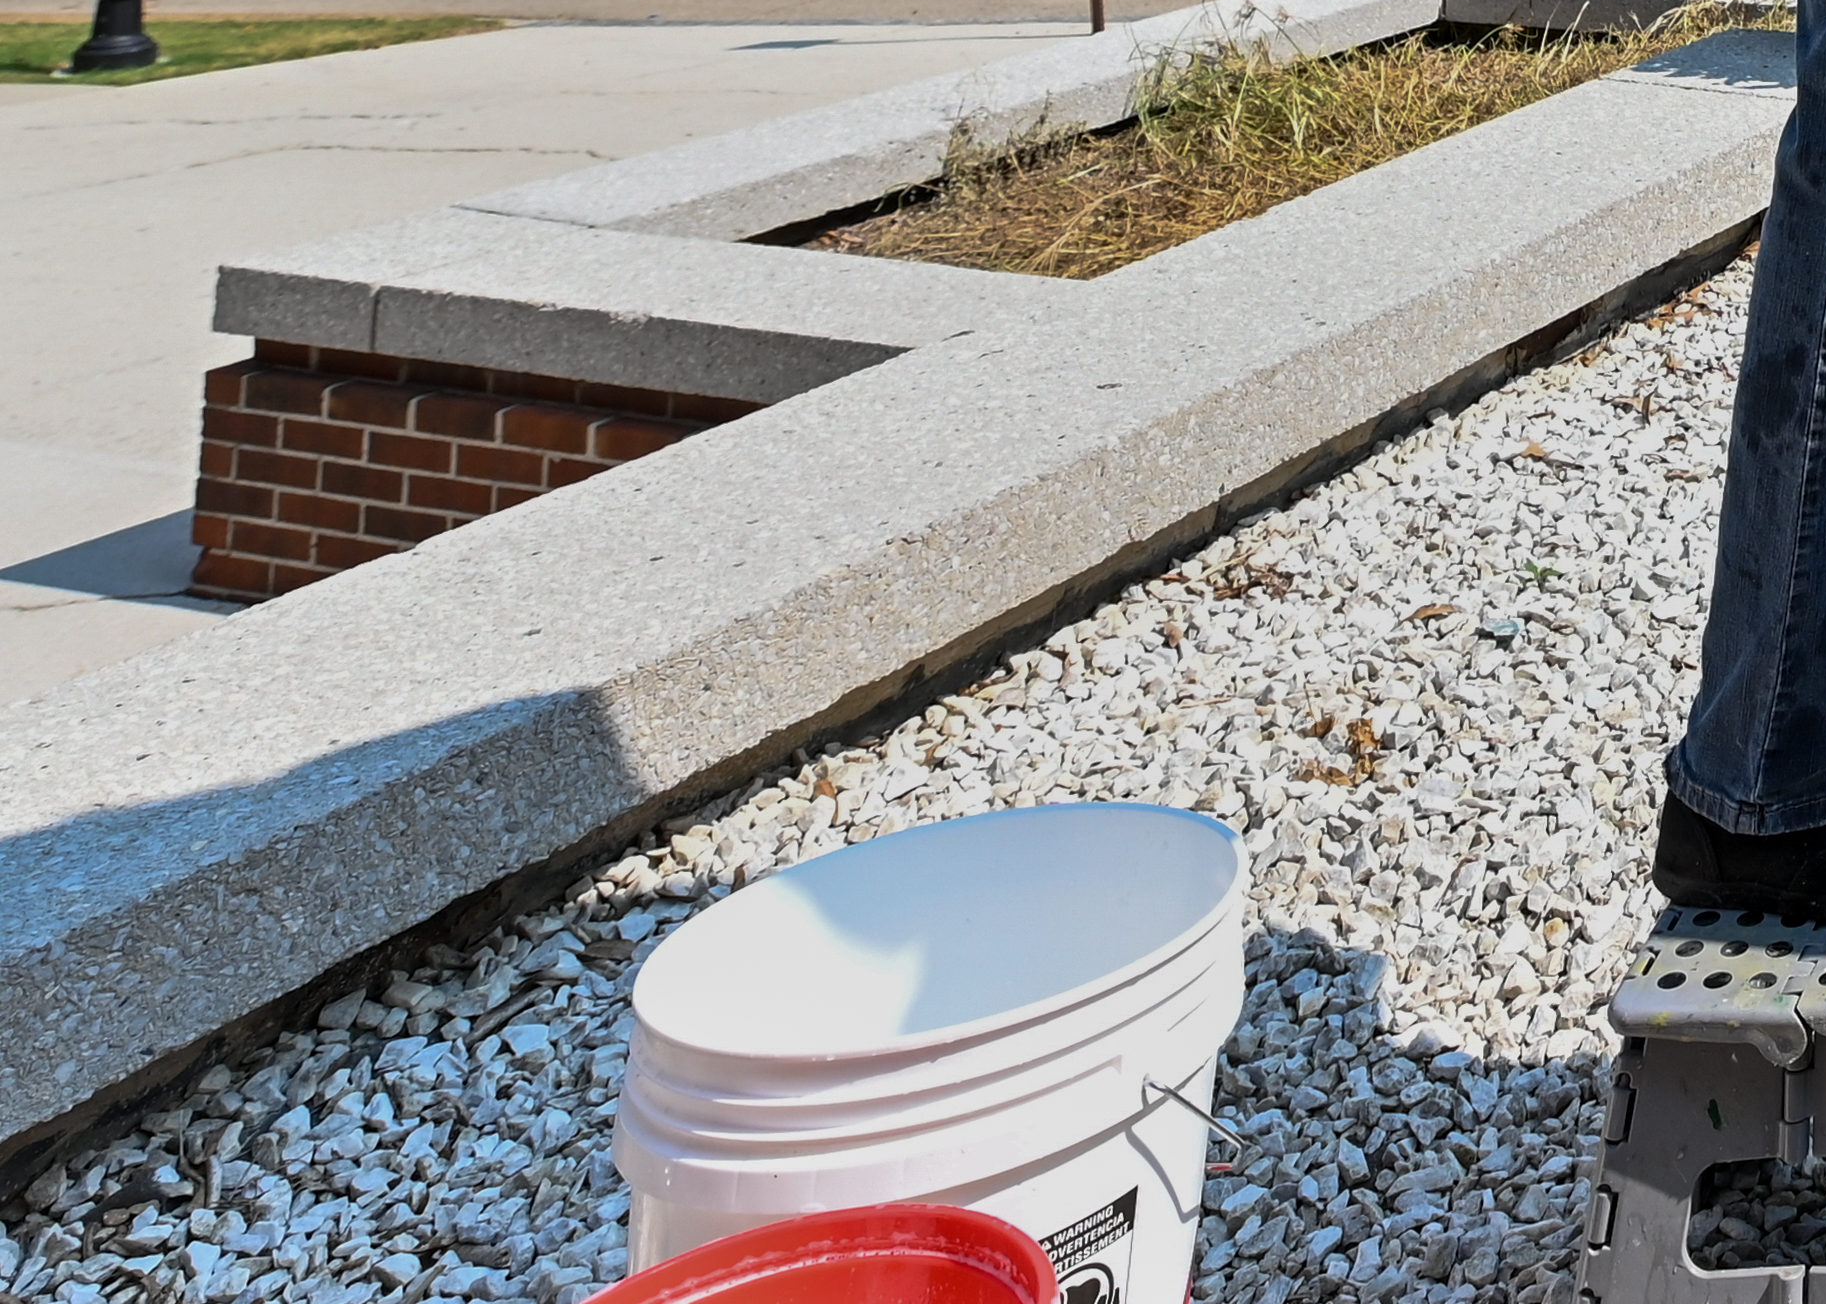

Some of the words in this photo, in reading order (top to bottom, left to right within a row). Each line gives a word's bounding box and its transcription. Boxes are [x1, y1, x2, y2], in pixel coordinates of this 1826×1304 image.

[1048, 1212, 1125, 1262] DVERTENCIA
[1053, 1205, 1114, 1247] WARNING
[1054, 1221, 1130, 1273] RTISSEMENT
